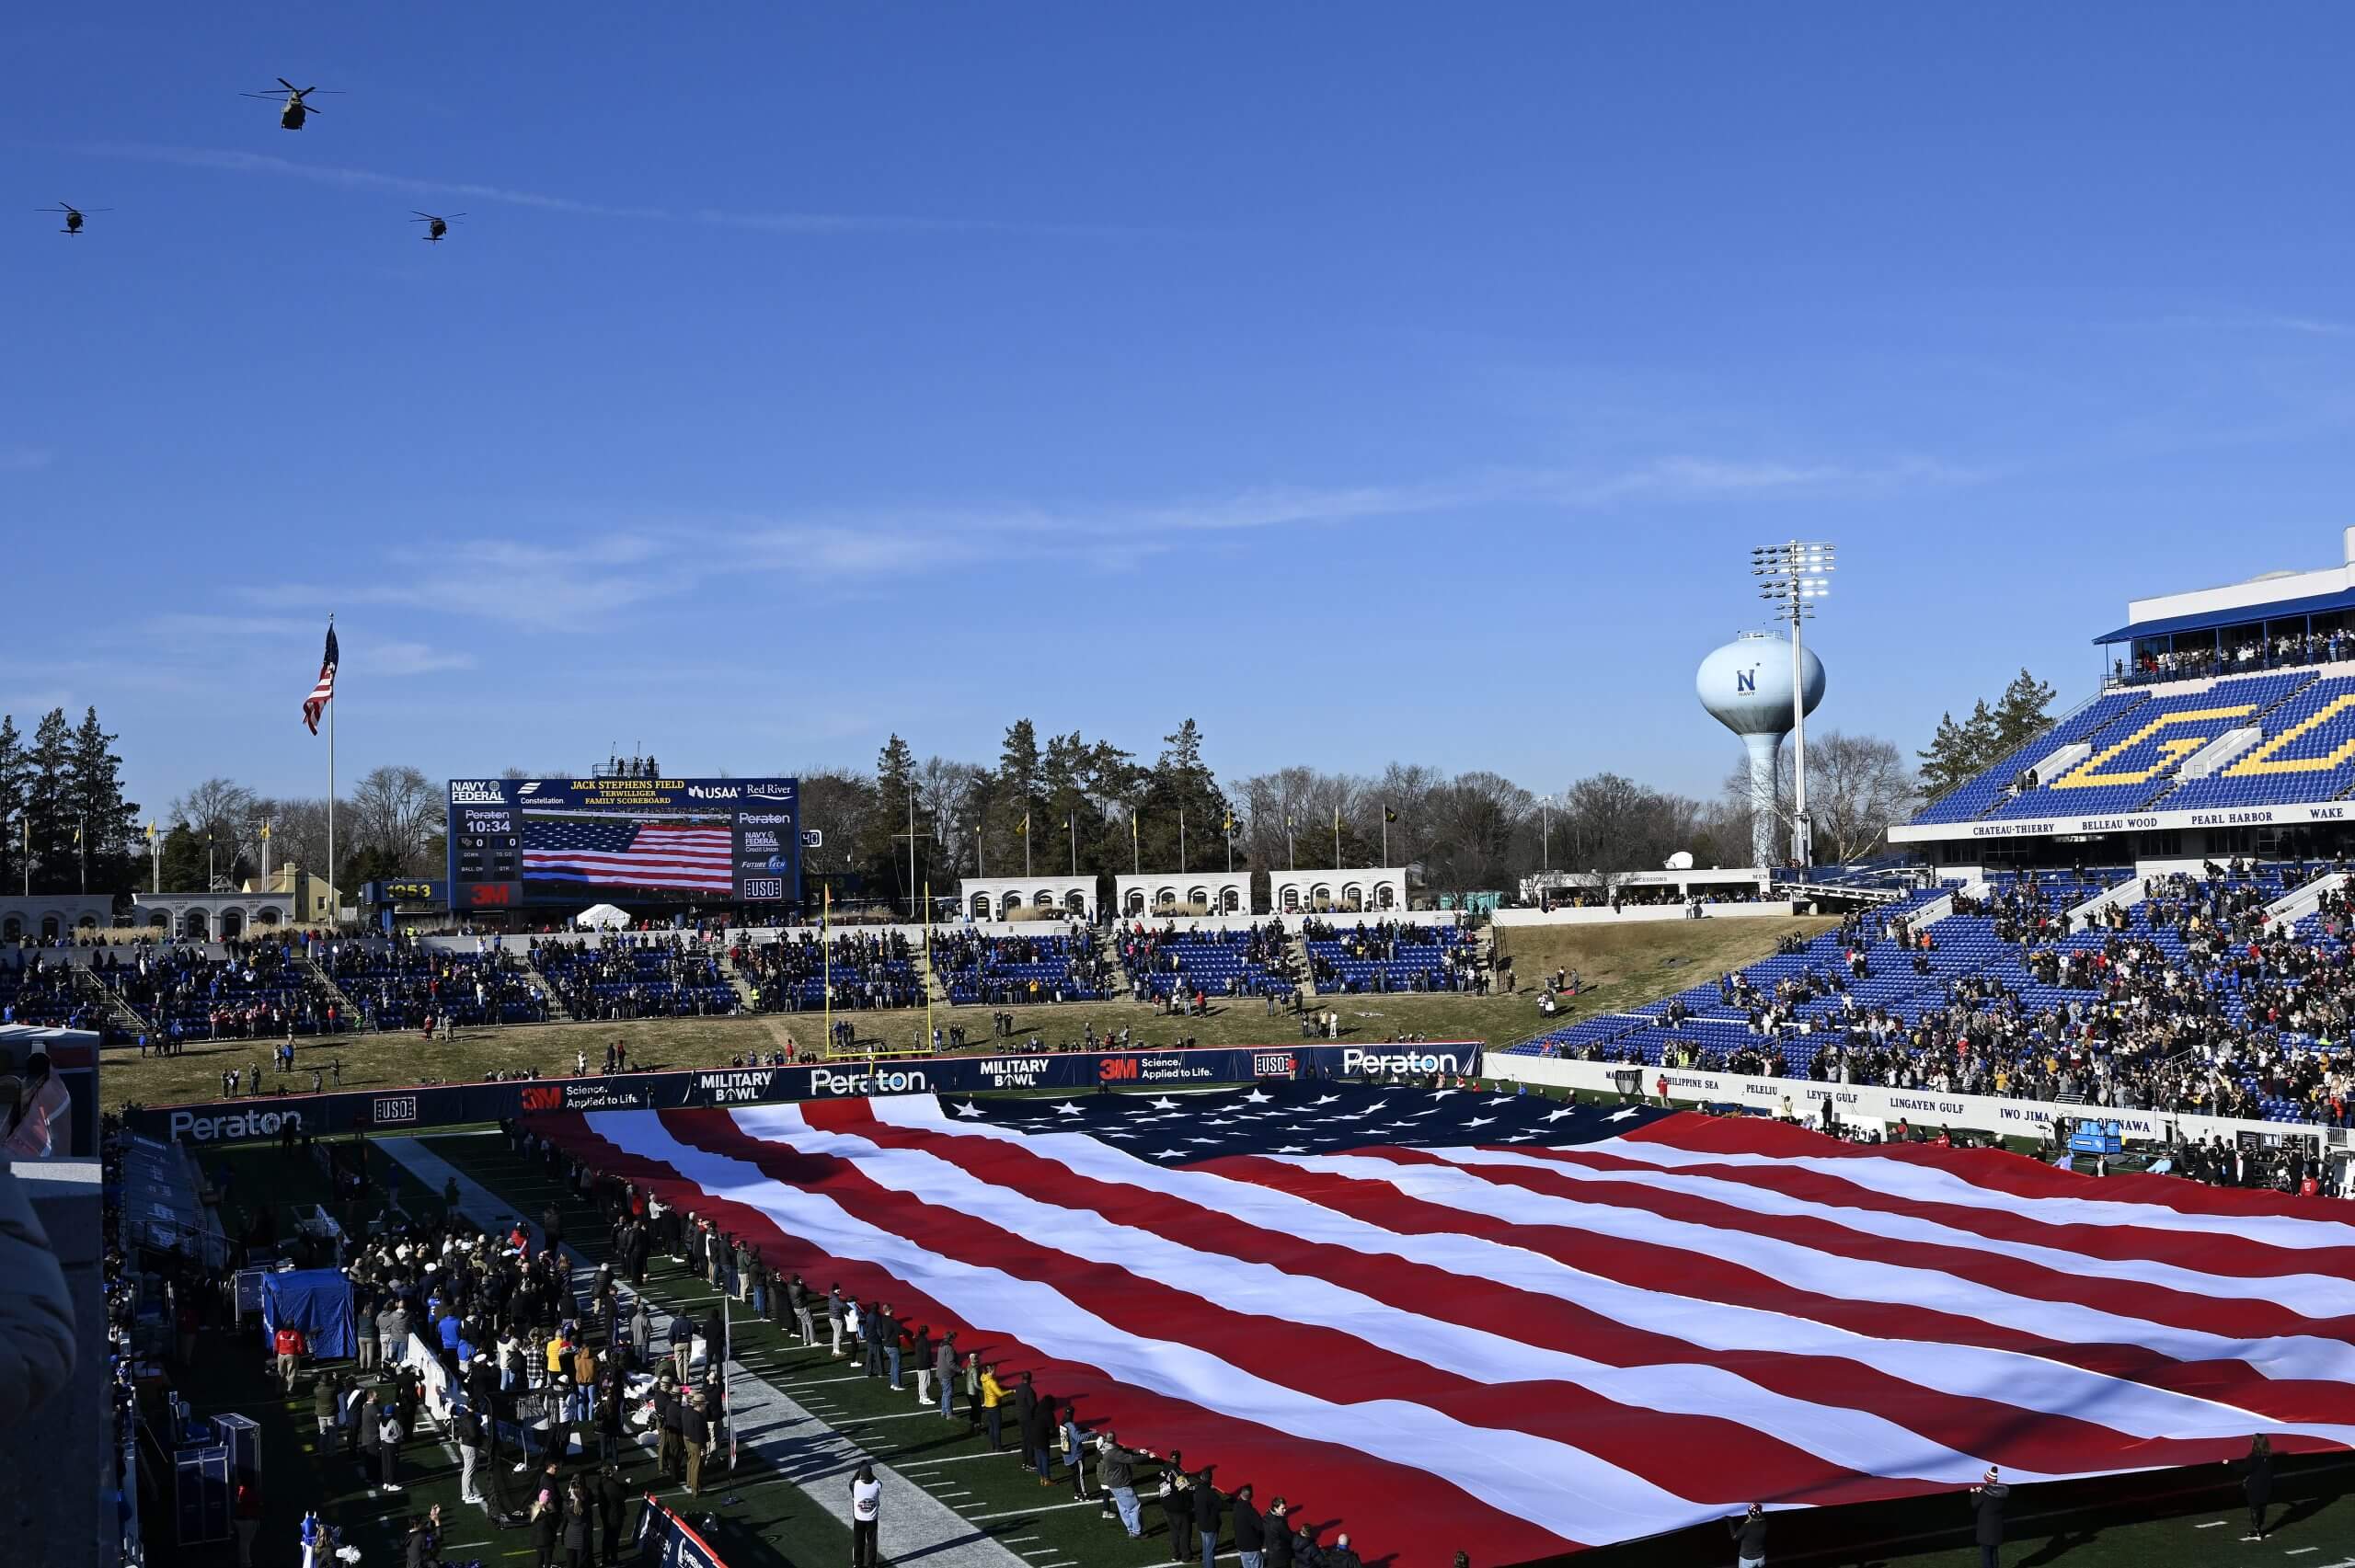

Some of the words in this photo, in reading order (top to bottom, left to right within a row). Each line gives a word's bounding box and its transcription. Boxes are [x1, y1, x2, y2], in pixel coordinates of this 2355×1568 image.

[1737, 670, 1755, 692] N
[452, 782, 486, 791] NAVY
[571, 781, 595, 790] JACK
[598, 781, 652, 789] STEPHENS
[655, 780, 684, 789] FIELD
[747, 784, 765, 794] Red
[767, 784, 791, 794] River
[452, 791, 505, 801] FEDERAL
[706, 787, 738, 798] USAA
[465, 810, 510, 819] Peraton
[739, 812, 790, 824] Peraton
[2191, 814, 2225, 825] PEARL
[2229, 811, 2273, 823] HARBOR
[2310, 807, 2344, 819] WAKE
[466, 821, 511, 832] 10:34
[1973, 824, 2055, 836] CHATEAU-THIERRY
[2082, 819, 2123, 830] BELLEAU
[2127, 818, 2157, 828] WOOD
[476, 839, 483, 847] 0
[509, 838, 516, 846] 0
[802, 833, 818, 843] 40
[471, 885, 509, 905] 3M
[752, 881, 775, 897] USO
[980, 1059, 1049, 1075] MILITARY
[1142, 1058, 1181, 1068] Science.
[1262, 1057, 1284, 1072] USO
[1343, 1048, 1458, 1074] Peraton
[1098, 1059, 1137, 1080] 3M
[1142, 1068, 1178, 1080] Applied
[1180, 1068, 1190, 1077] to
[1192, 1067, 1212, 1077] Life.
[701, 1071, 773, 1089] MILITARY
[1605, 1070, 1639, 1082] MARIANA
[810, 1069, 925, 1096] Peraton
[1705, 1080, 1719, 1090] SEA
[566, 1085, 608, 1095] Science.
[1746, 1084, 1778, 1095] PELELIU
[522, 1087, 560, 1110] 3M
[566, 1095, 605, 1109] Applied
[607, 1096, 618, 1104] to
[1807, 1090, 1832, 1101] LEYTE
[1835, 1093, 1858, 1104] GULF
[383, 1100, 408, 1119] USO
[1890, 1097, 1936, 1111] LINGAYEN
[1939, 1103, 1965, 1115] GULF
[2000, 1108, 2020, 1119] IWO
[2024, 1110, 2051, 1122] JIMA
[170, 1109, 302, 1142] Peraton
[2097, 1117, 2151, 1132] OKNAWA
